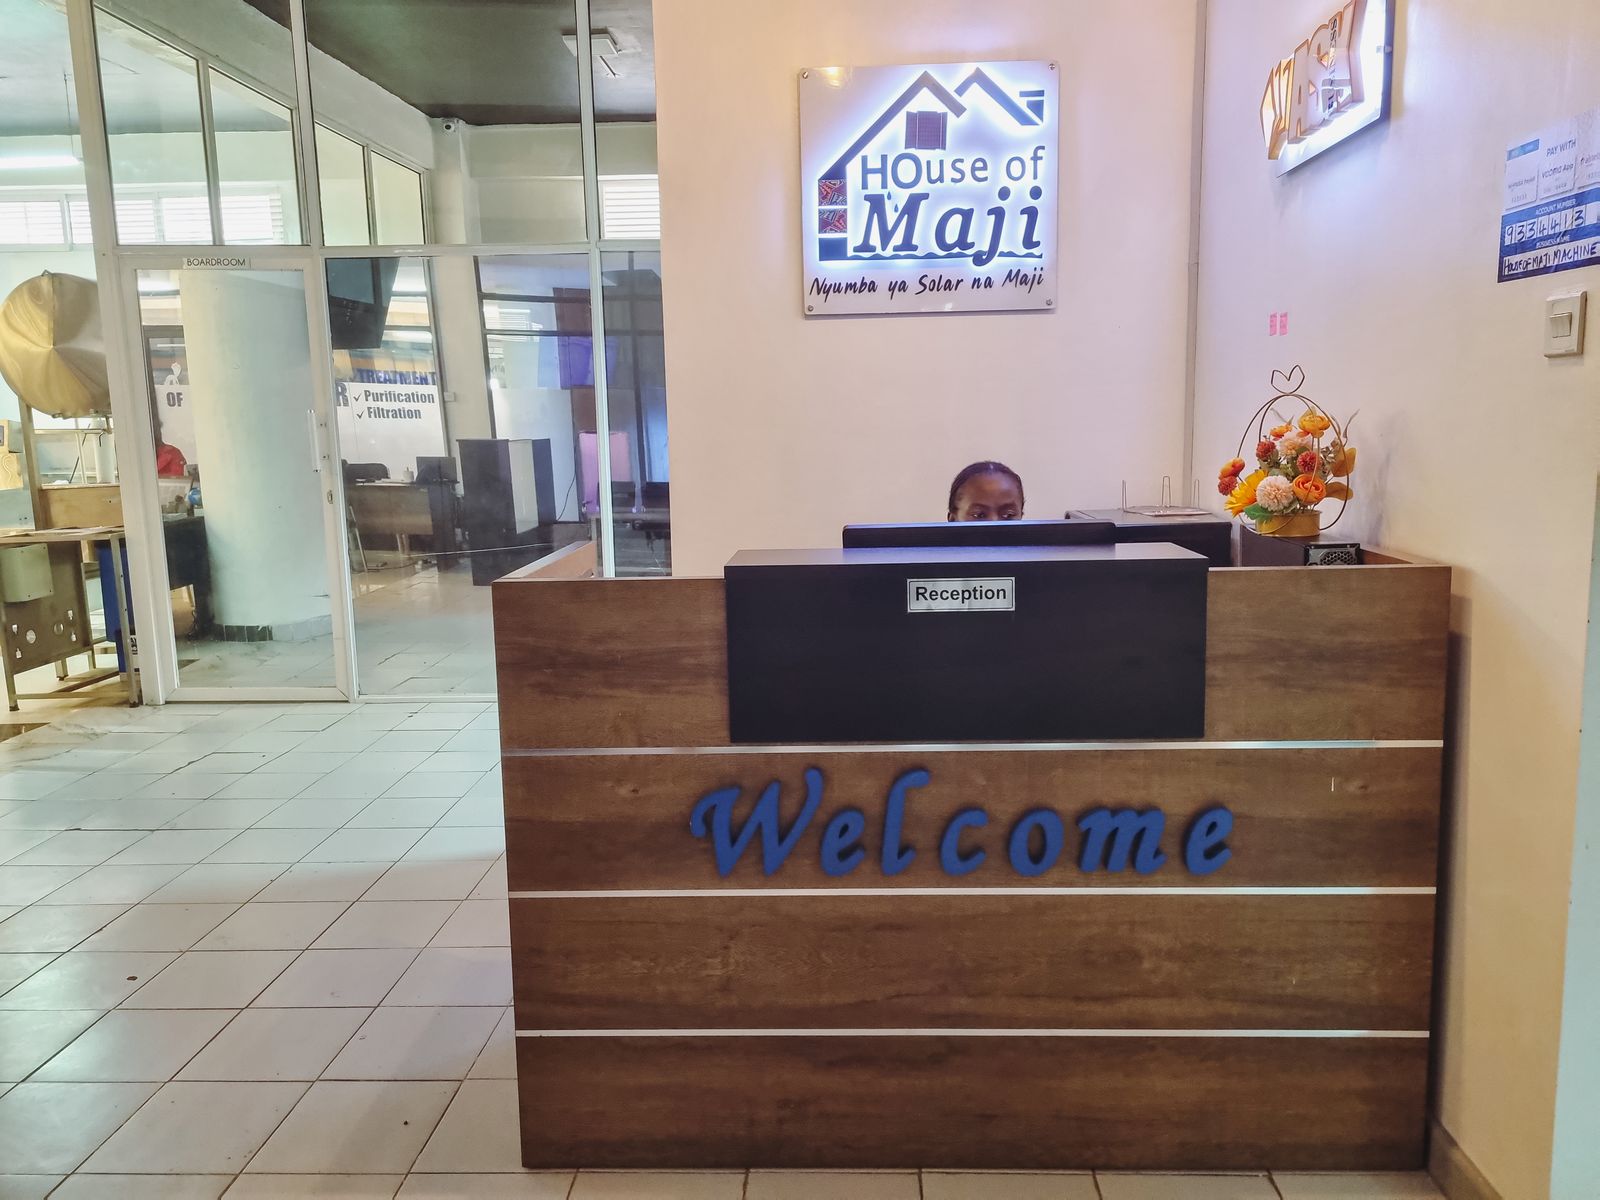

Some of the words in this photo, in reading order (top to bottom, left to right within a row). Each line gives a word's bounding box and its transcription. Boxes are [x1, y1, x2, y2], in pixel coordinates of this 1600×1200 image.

[1546, 145, 1559, 157] PAY
[1559, 138, 1577, 153] WITH
[1005, 145, 1046, 181] of
[1535, 204, 1556, 215] ACCOUNT
[852, 186, 1043, 267] Maji
[187, 258, 246, 267] BOARDROOM
[809, 276, 878, 303] Nyumba
[887, 281, 909, 300] ya
[915, 274, 963, 295] Solar
[971, 275, 994, 290] na
[1002, 267, 1045, 294] Maji
[356, 368, 437, 386] TREATMENT
[166, 391, 184, 408] OF
[364, 389, 435, 404] Purification
[367, 406, 422, 419] Filtration
[915, 585, 1007, 604] Reception
[689, 766, 1235, 878] Welcome
